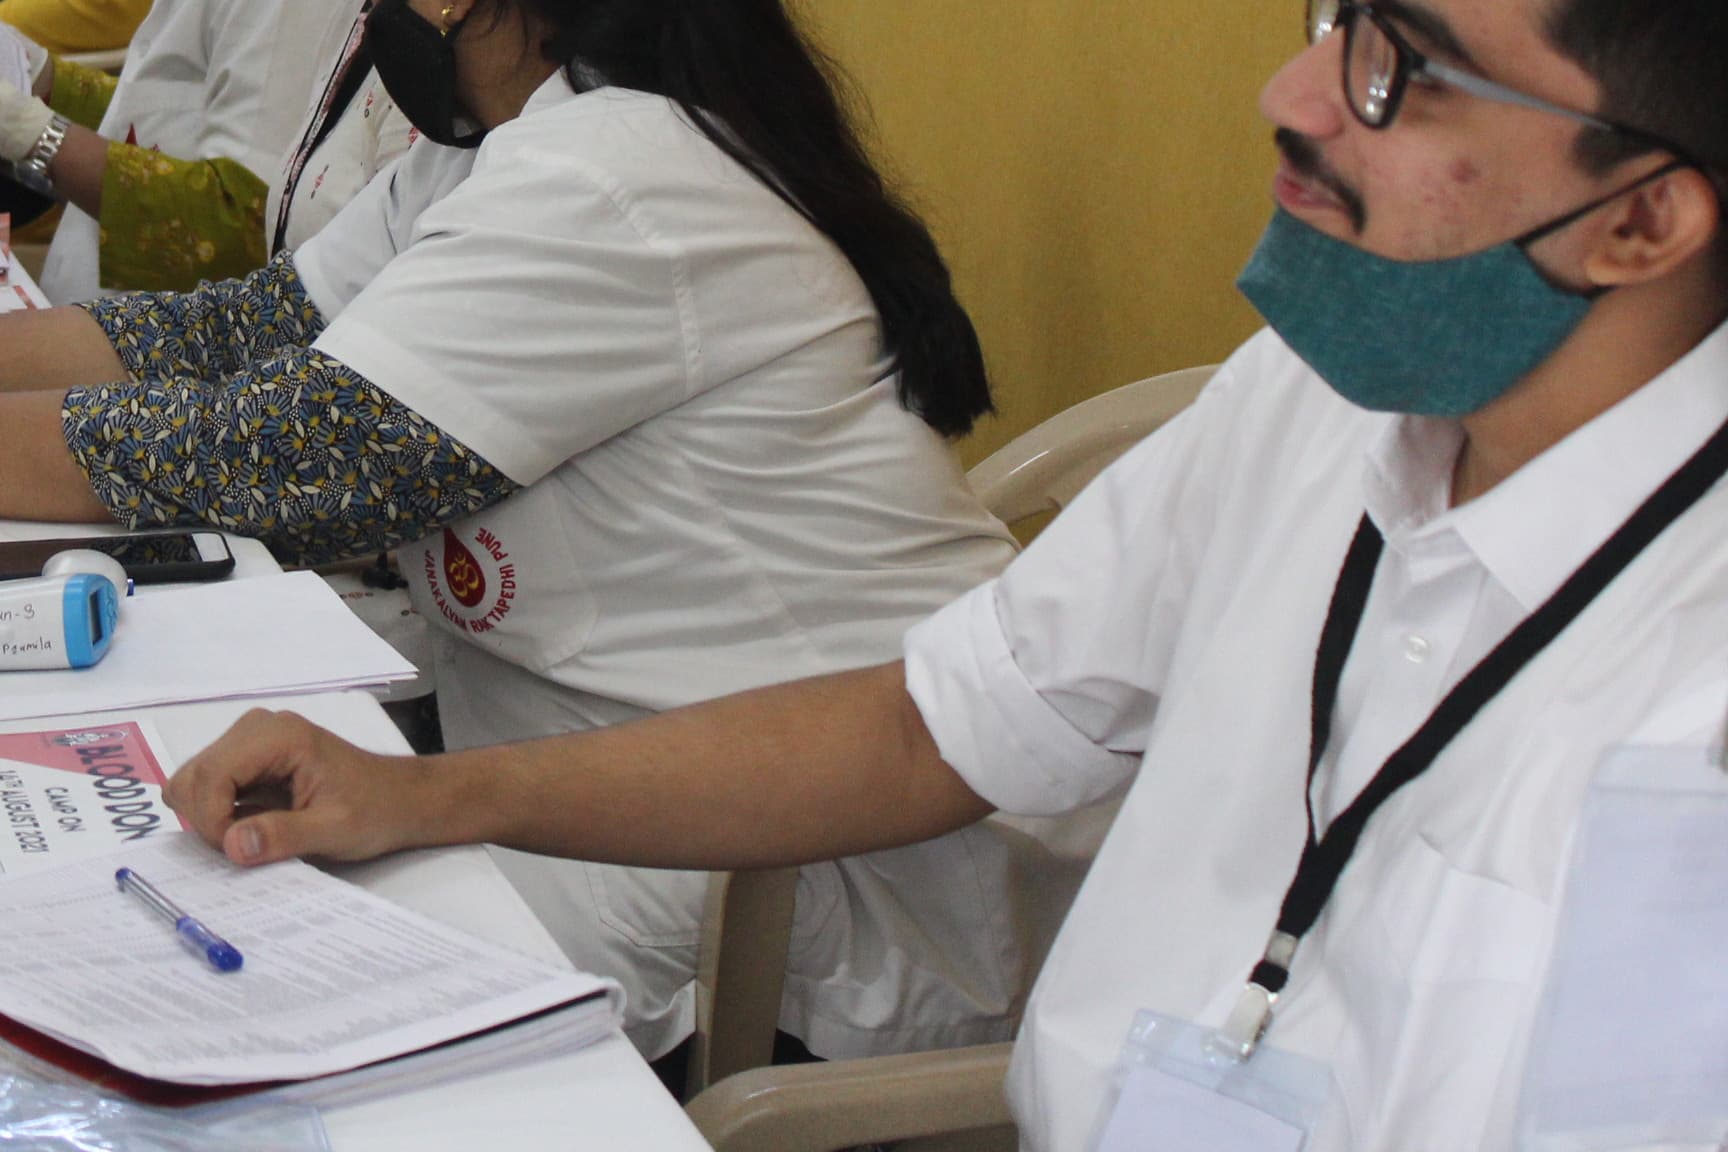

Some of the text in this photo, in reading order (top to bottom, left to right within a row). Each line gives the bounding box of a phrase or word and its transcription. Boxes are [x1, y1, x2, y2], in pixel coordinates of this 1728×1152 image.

[474, 527, 509, 562] PUNE
[75, 744, 147, 802] BLOOD
[0, 787, 40, 833] AUGUST
[44, 786, 87, 833] CAMP ON
[17, 828, 50, 854] 2021
